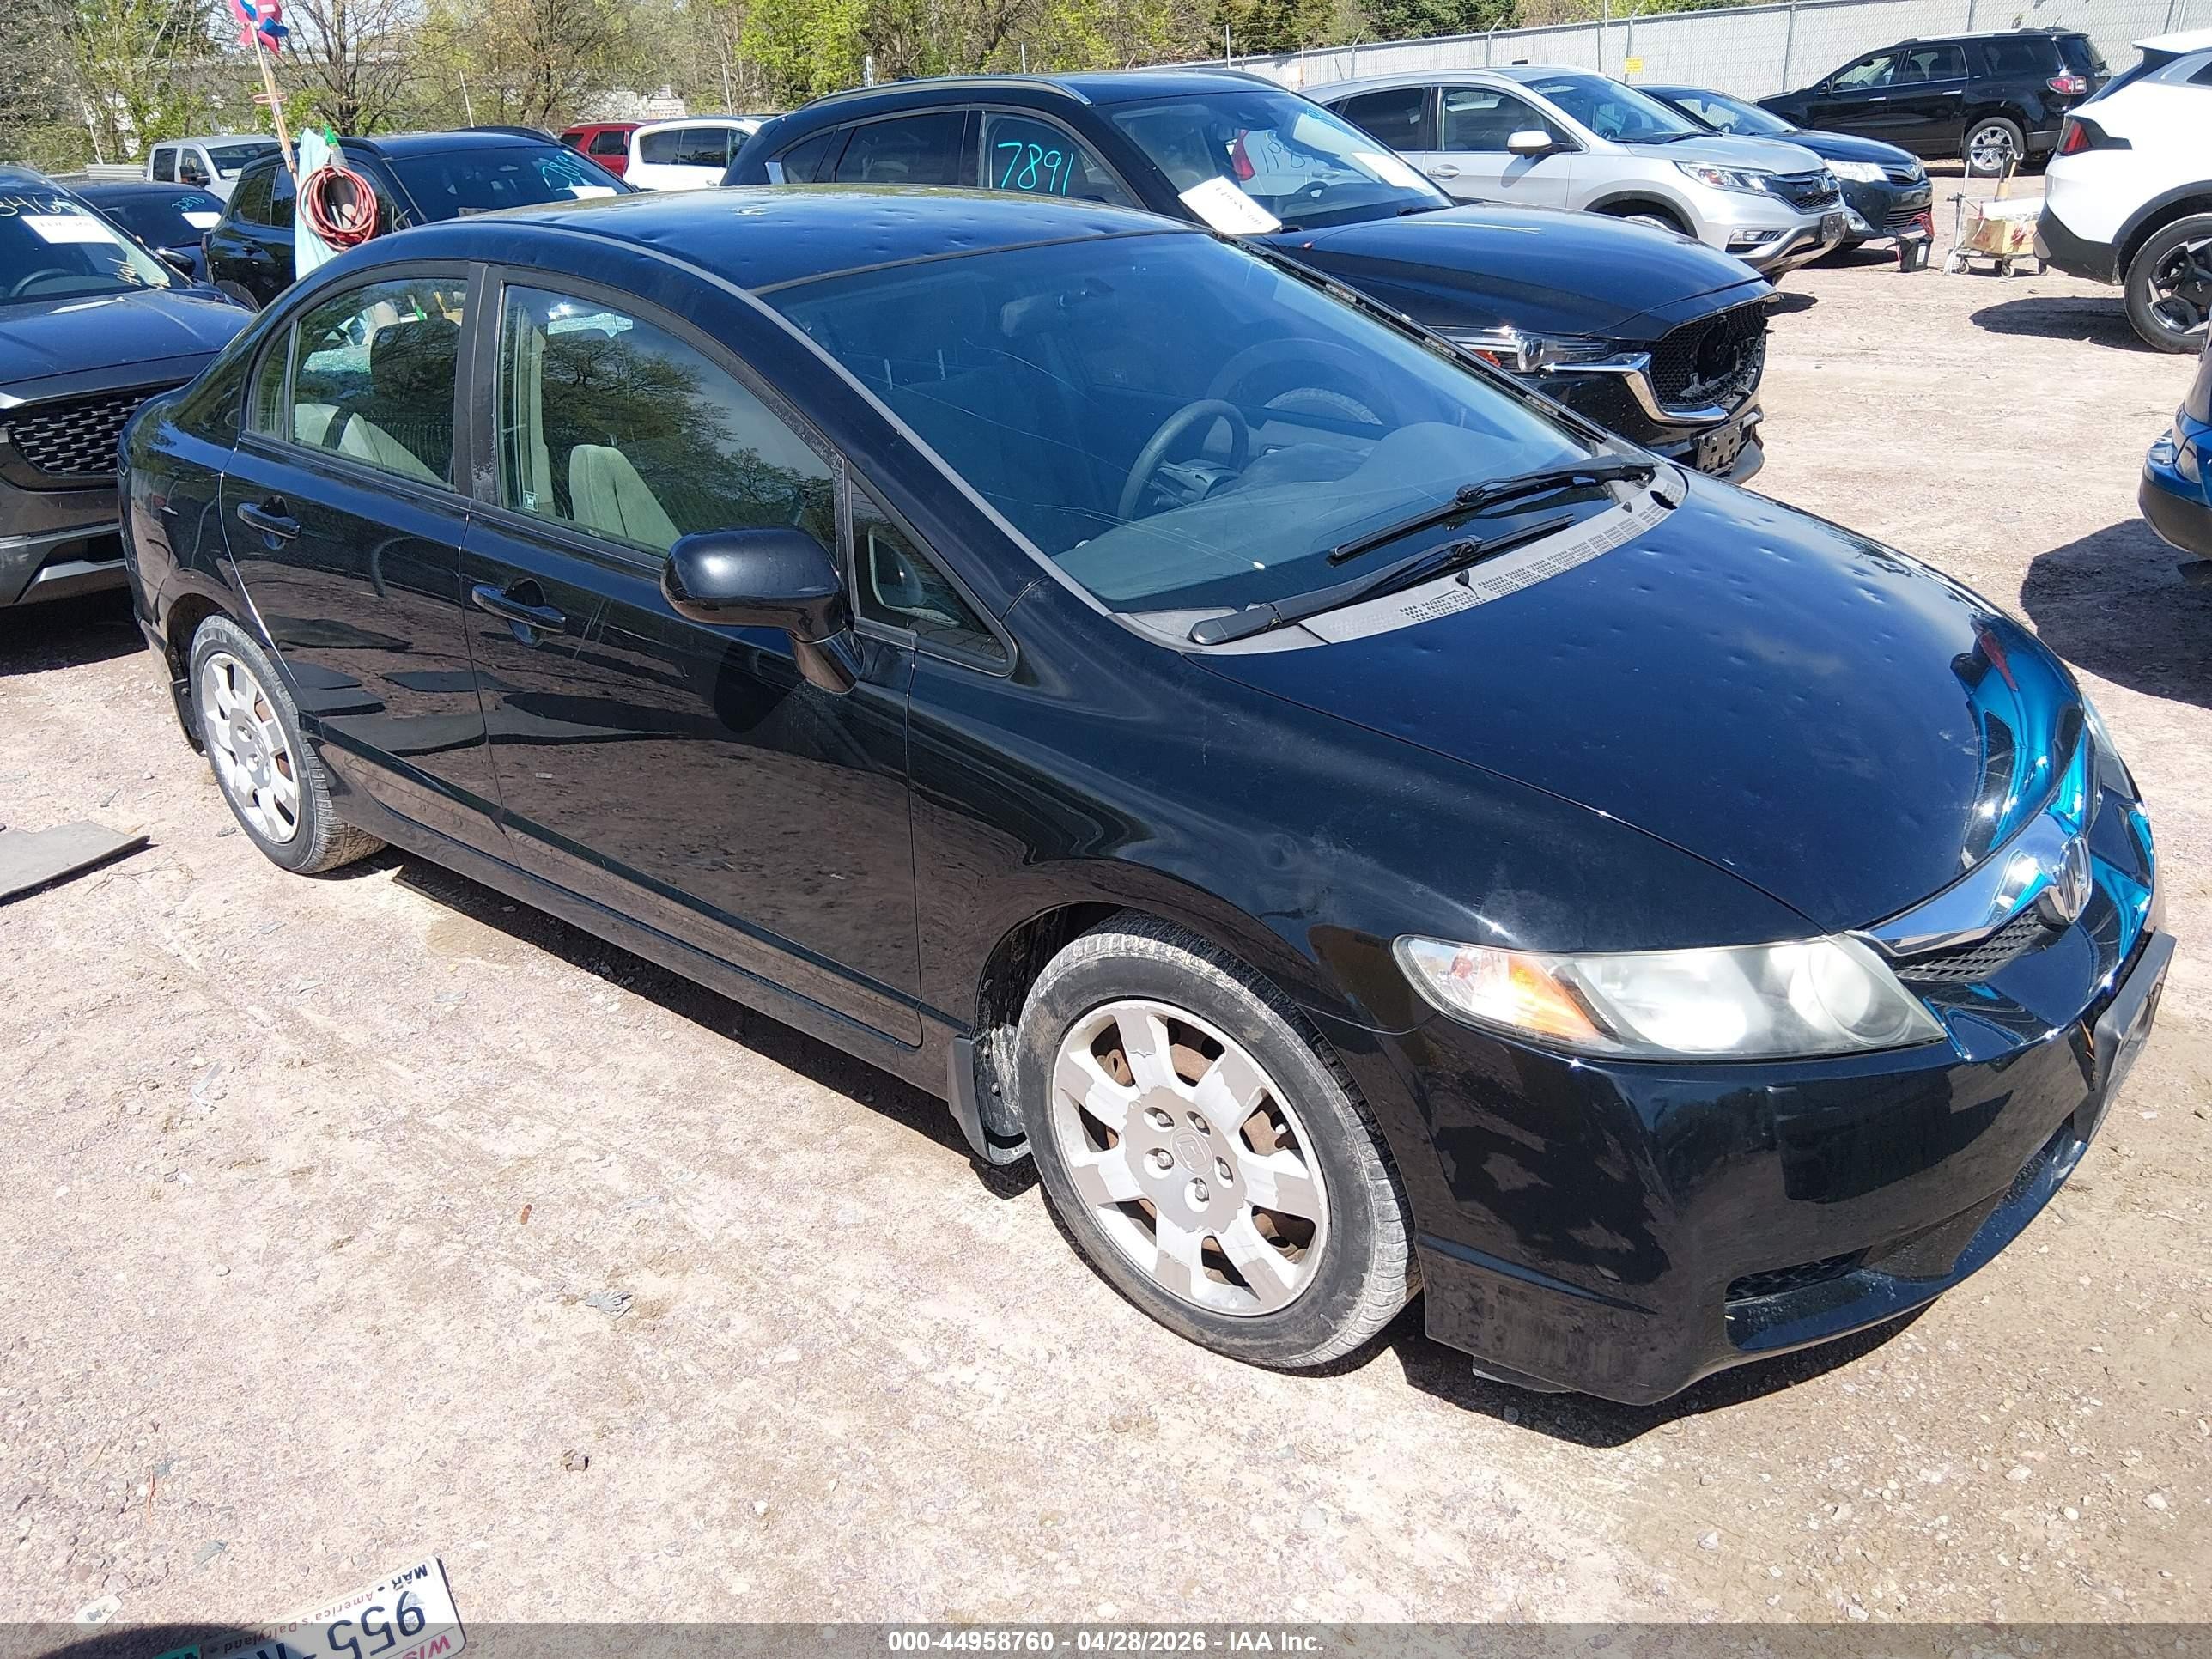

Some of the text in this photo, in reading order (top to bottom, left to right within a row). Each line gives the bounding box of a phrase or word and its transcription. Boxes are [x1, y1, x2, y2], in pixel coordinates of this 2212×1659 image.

[997, 142, 1074, 196] 7891
[391, 1564, 429, 1590] MAR
[223, 1592, 374, 1654] America's Dairyland
